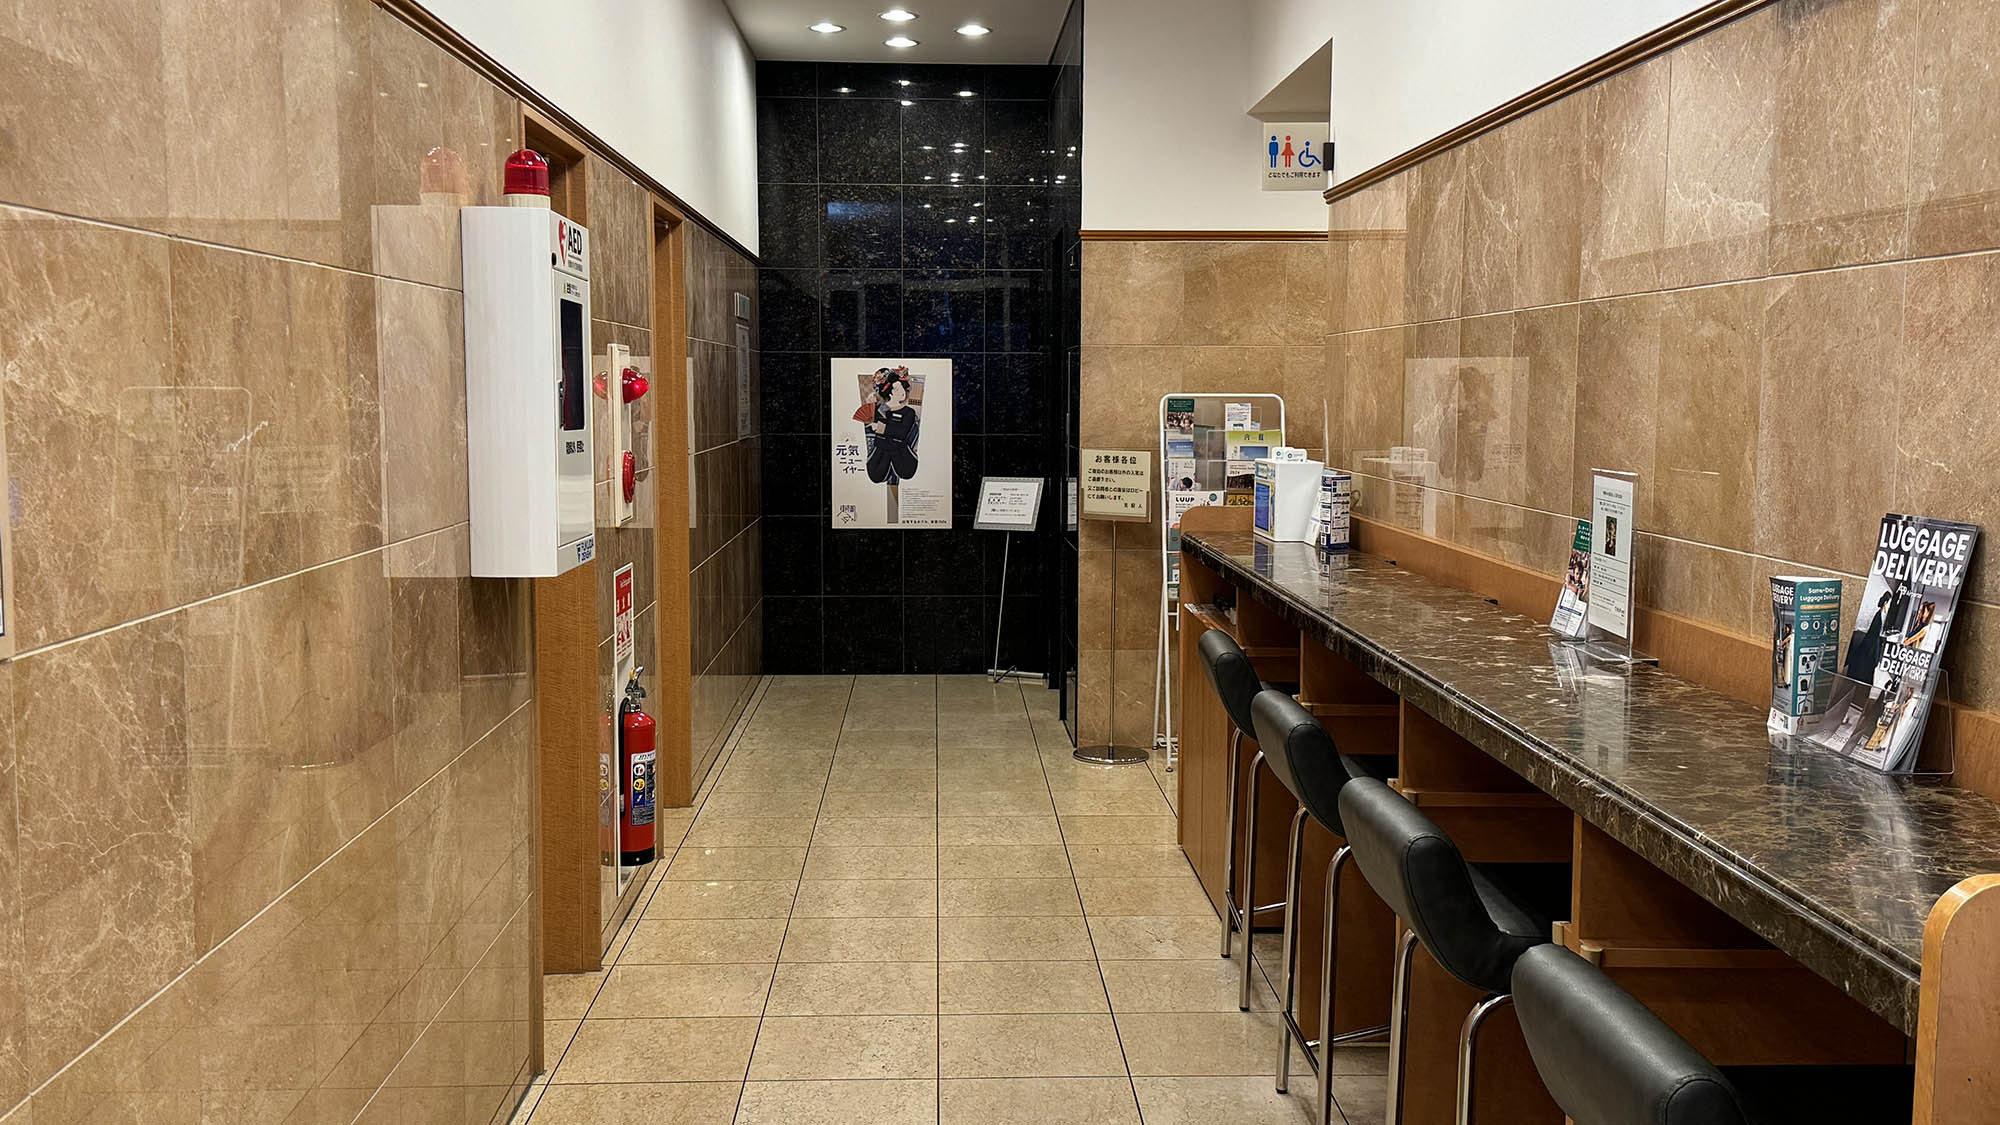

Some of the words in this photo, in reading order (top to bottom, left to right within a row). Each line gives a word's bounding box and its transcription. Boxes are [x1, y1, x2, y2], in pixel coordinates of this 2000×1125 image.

[1268, 171, 1321, 179] どなたでもご利用できます
[568, 226, 582, 256] AED
[836, 444, 859, 456] 元気
[839, 457, 862, 465] ニュー
[1095, 455, 1137, 465] お客様各位
[842, 466, 865, 474] イヤー
[1880, 522, 1971, 562] LUGGAGE
[1872, 550, 1963, 590] DELIVERY
[1800, 595, 1823, 603] Luggage
[1883, 643, 1932, 668] LUGGAGE
[1880, 657, 1928, 681] DELIVERY
